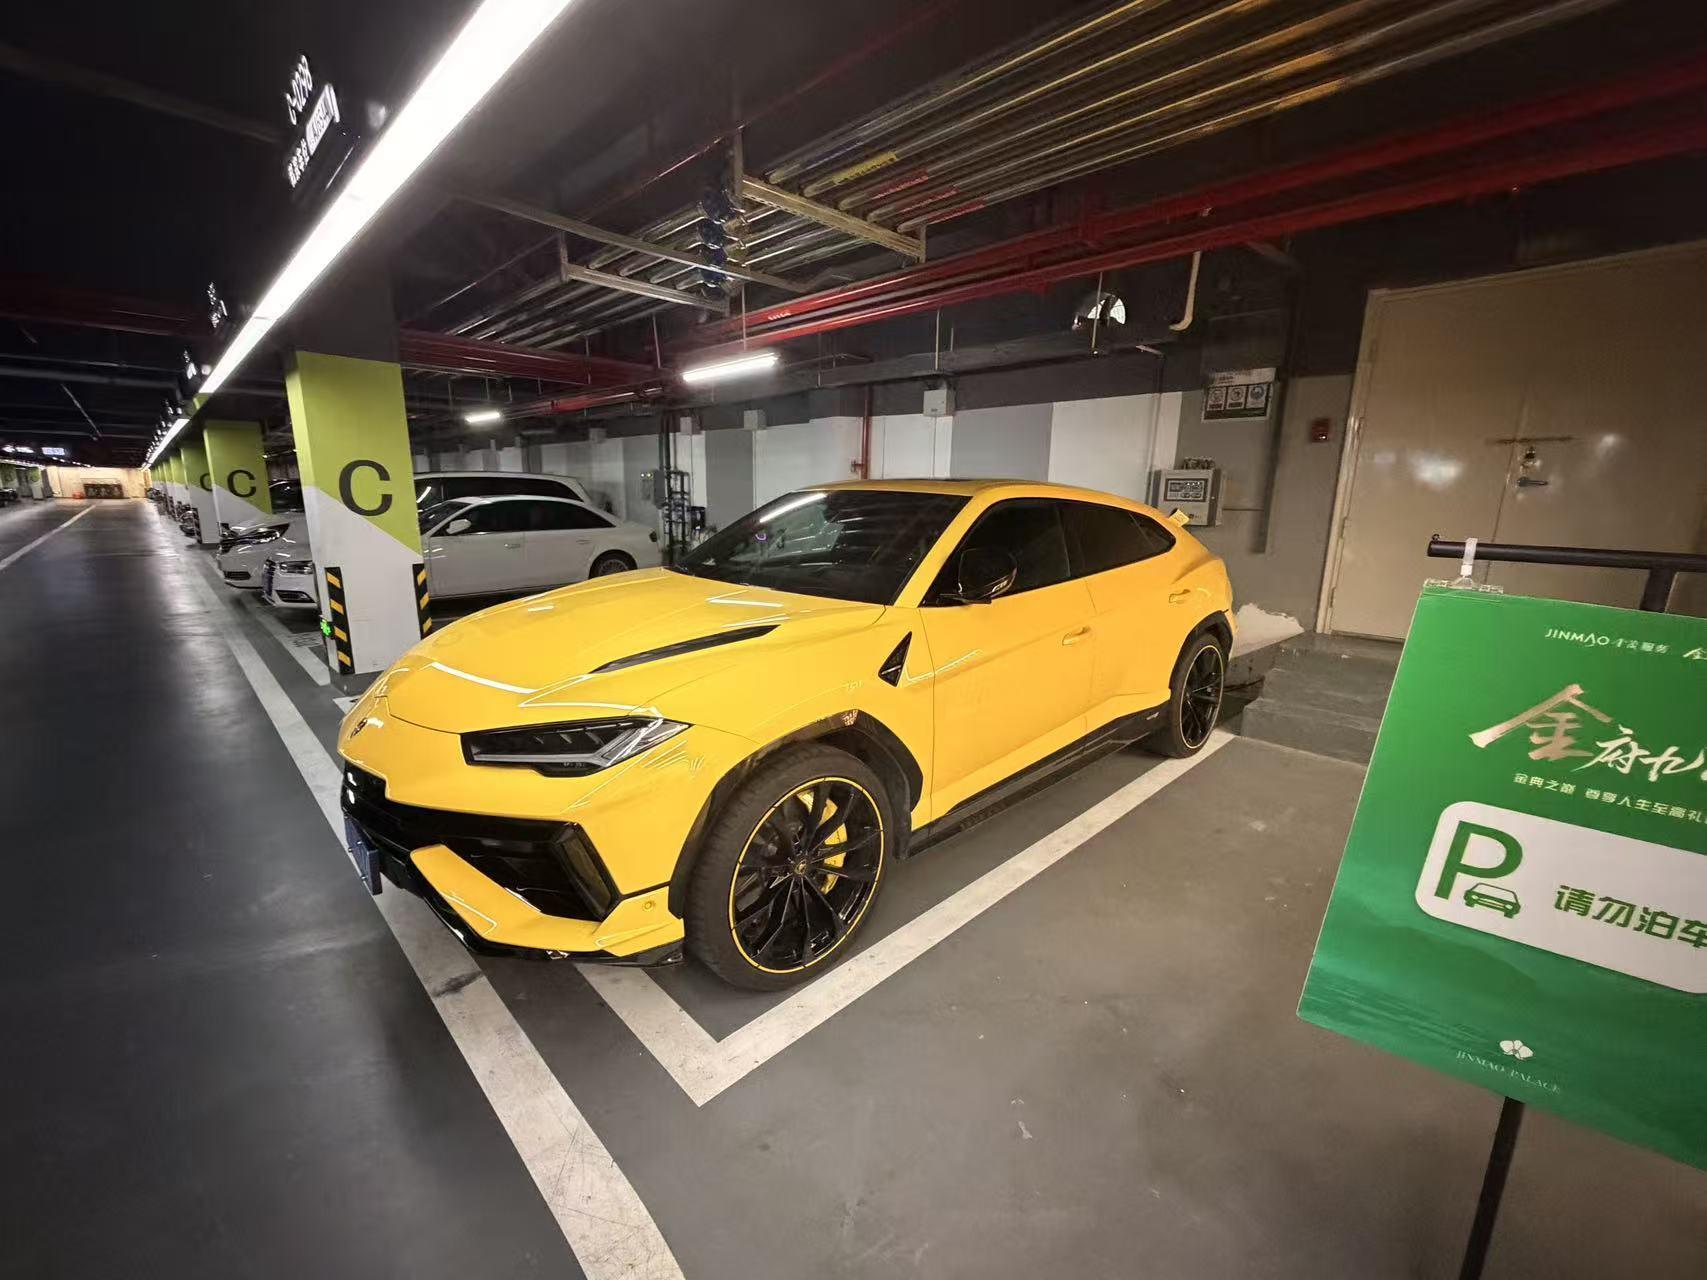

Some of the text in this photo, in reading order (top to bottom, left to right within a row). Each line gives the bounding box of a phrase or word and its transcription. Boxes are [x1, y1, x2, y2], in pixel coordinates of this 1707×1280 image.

[227, 469, 257, 498] C
[338, 459, 394, 517] C
[1544, 628, 1611, 647] JINMAO
[1468, 683, 1707, 783] 金府九
[1585, 787, 1707, 826] 尊享人生至高礼
[1434, 820, 1523, 901] P
[1554, 884, 1707, 949] 请勿泊车
